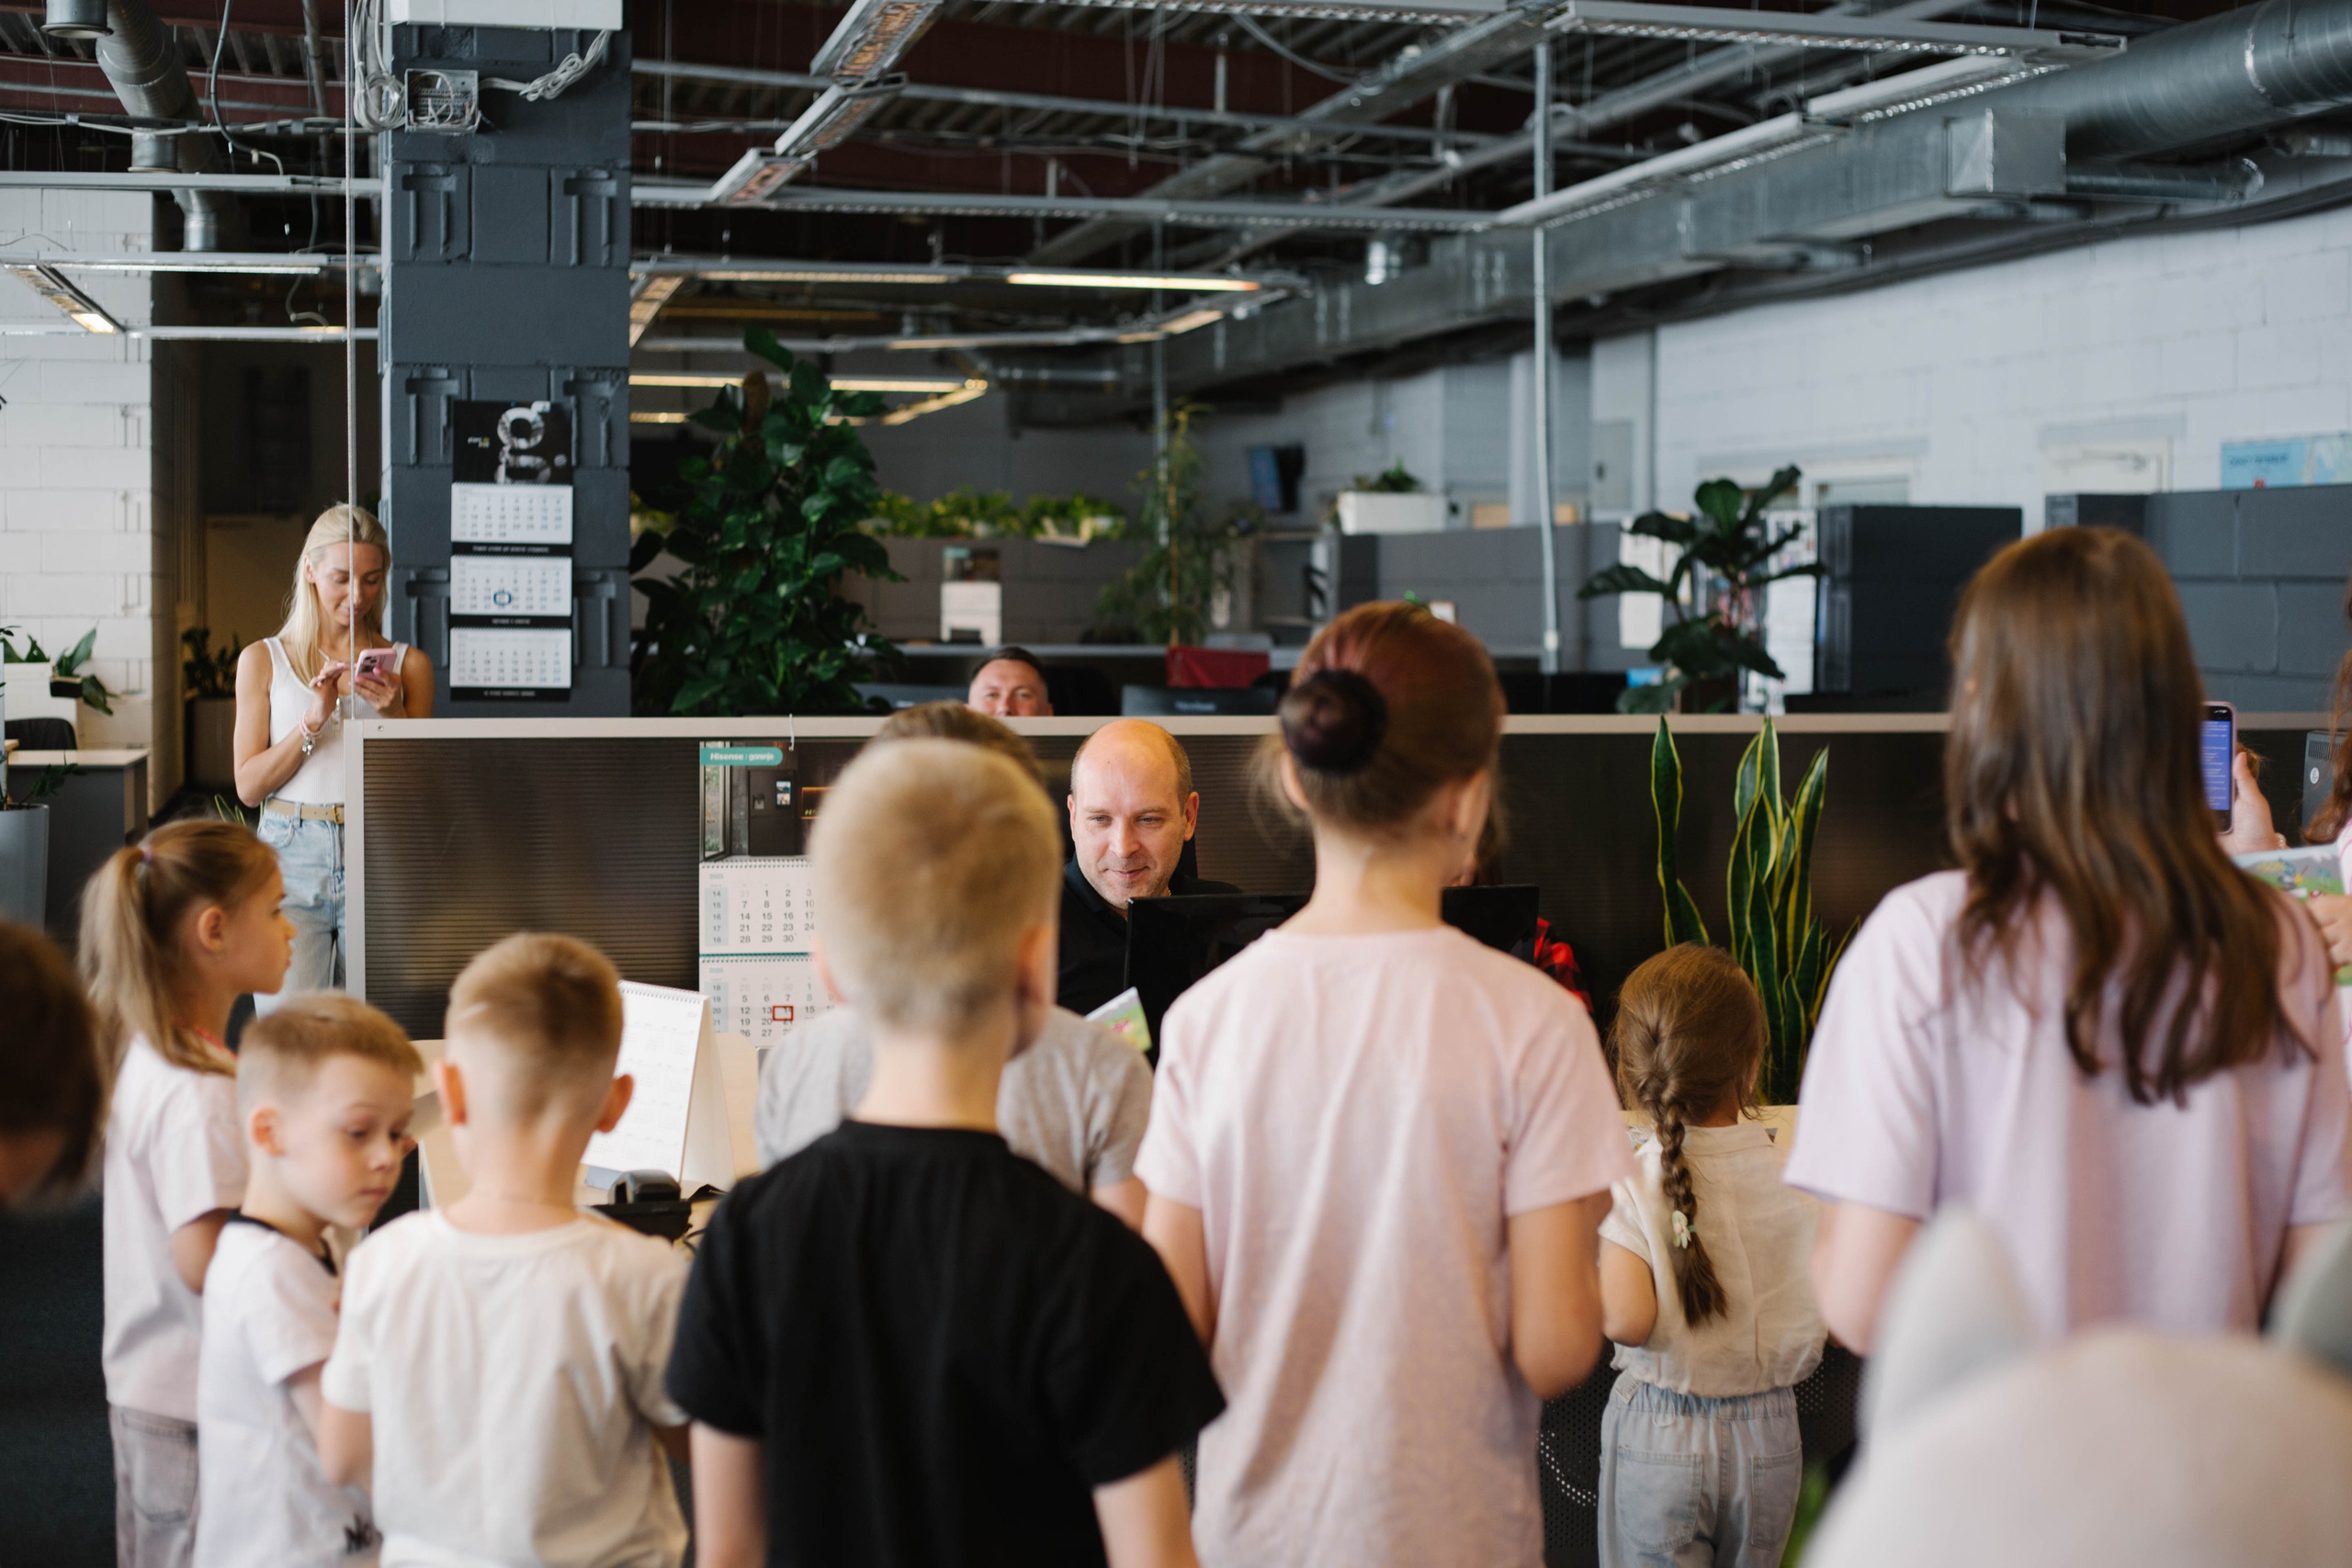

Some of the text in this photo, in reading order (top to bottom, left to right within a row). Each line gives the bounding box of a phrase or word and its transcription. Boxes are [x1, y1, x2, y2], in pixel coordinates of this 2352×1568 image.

[710, 752, 743, 761] Hisense
[749, 752, 775, 761] gorenje
[763, 900, 770, 908] 8
[785, 900, 791, 908] 9
[762, 912, 773, 920] 15
[783, 923, 794, 931] 23
[762, 935, 773, 943] 29
[786, 994, 791, 1002] 7
